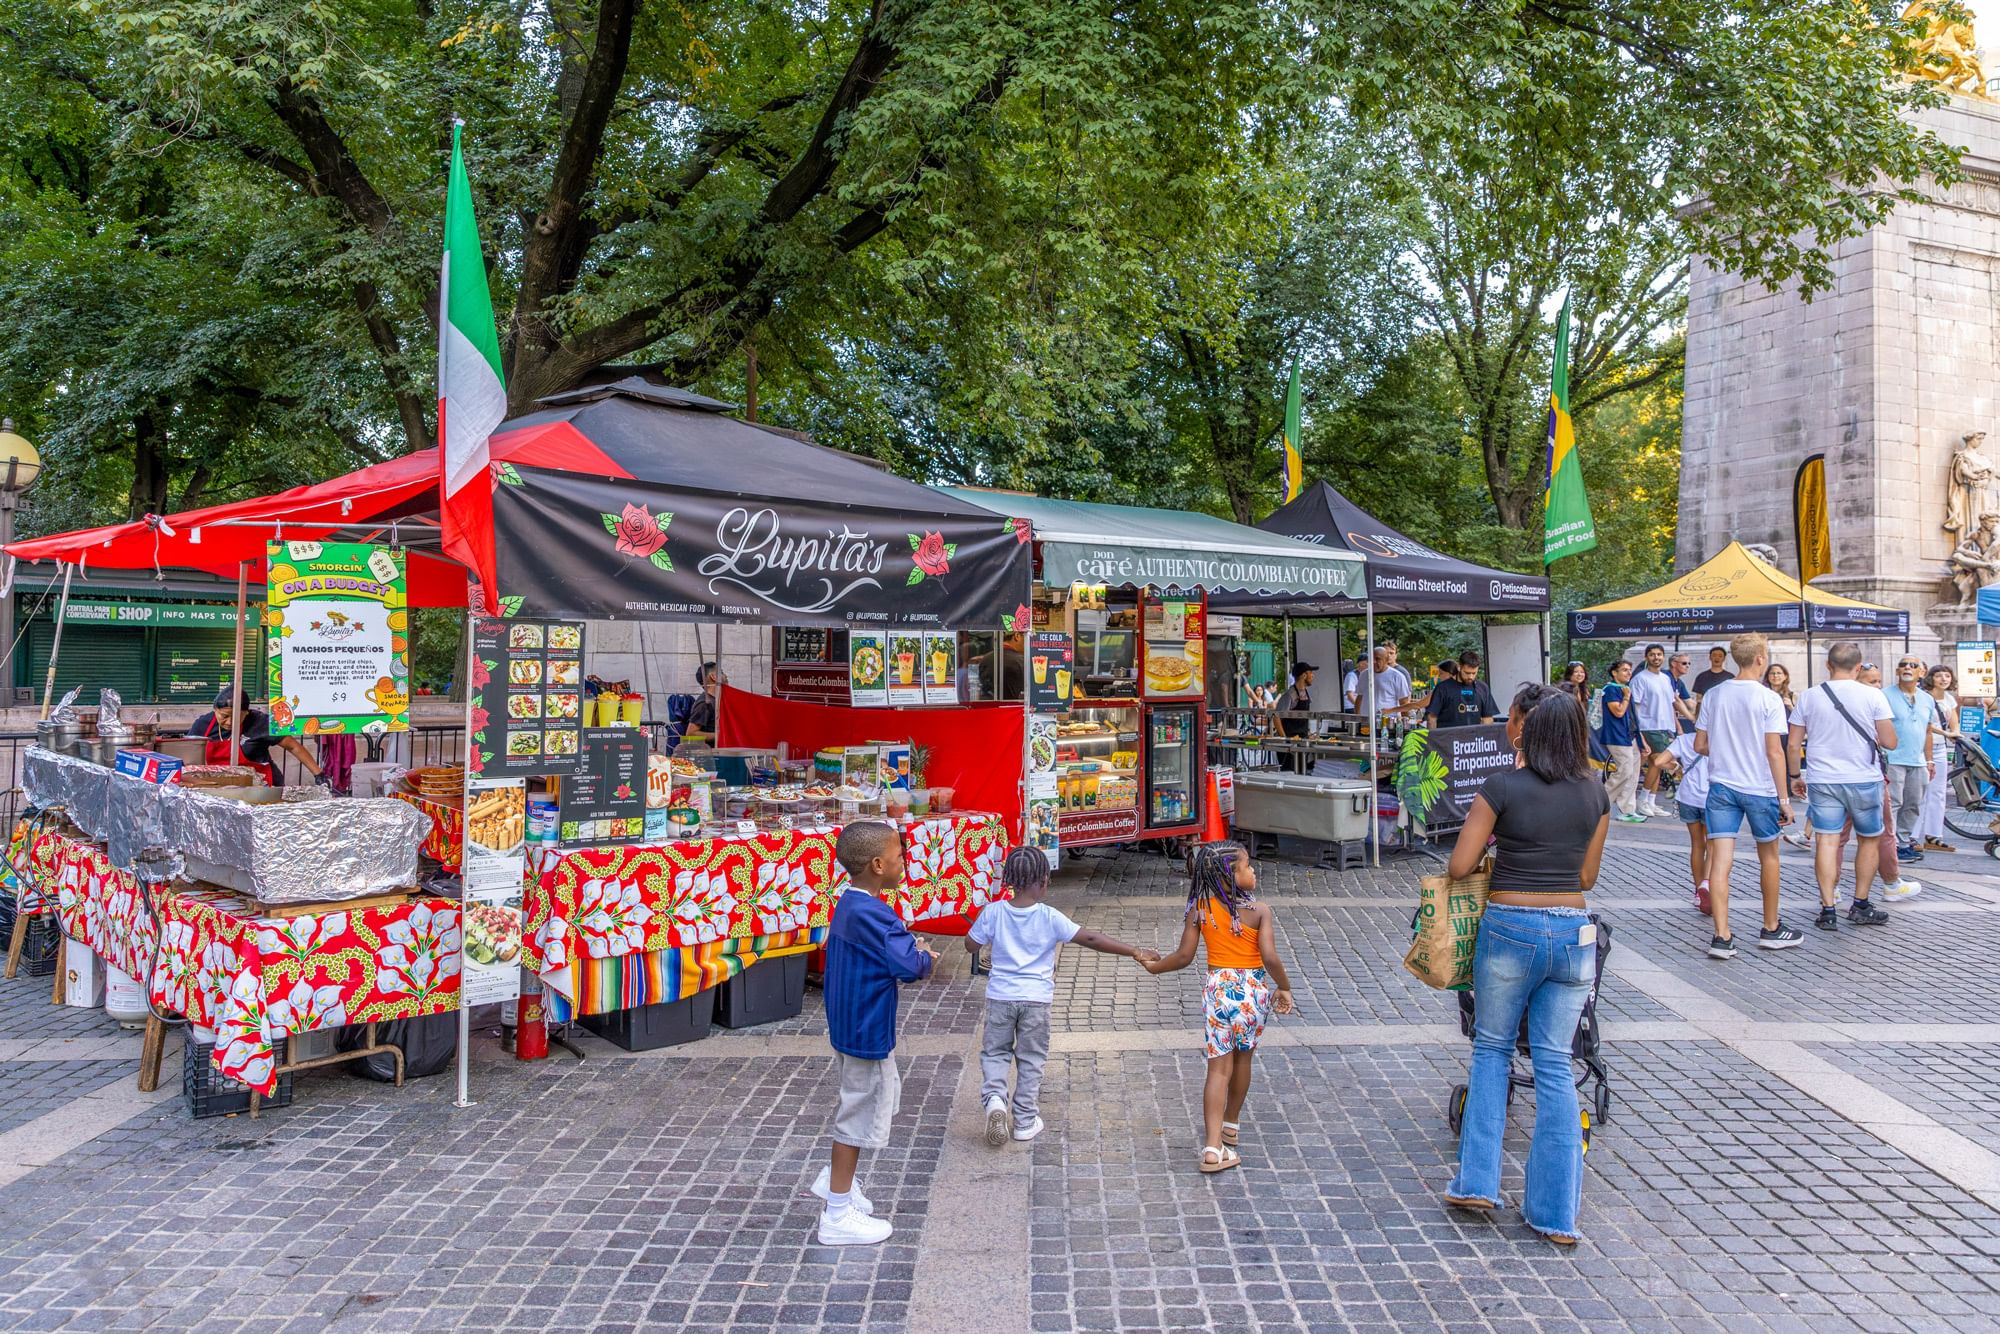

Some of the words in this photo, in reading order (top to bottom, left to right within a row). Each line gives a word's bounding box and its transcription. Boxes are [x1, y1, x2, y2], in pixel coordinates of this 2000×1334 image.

[1809, 504, 1818, 537] spoon
[1546, 520, 1585, 539] Brazilian
[1568, 529, 1594, 544] Food
[293, 544, 314, 556] $$$
[698, 507, 889, 587] Lupita's
[1810, 548, 1820, 569] bap
[309, 564, 364, 572] SMORGIN'
[1136, 560, 1218, 580] AUTHENTIC
[1220, 562, 1299, 584] COLOMBIAN
[1302, 568, 1348, 586] COFFEE
[284, 580, 306, 594] ON
[310, 580, 322, 590] A
[324, 578, 390, 596] BUDGET
[1376, 575, 1416, 592] Brazilian
[1418, 580, 1446, 592] Street
[1446, 581, 1468, 594] Food
[1502, 583, 1546, 596] PetiscoBrazuca
[66, 611, 110, 620] CONSERVANCY
[118, 606, 152, 620] SHOP
[625, 602, 659, 612] AUTHENTIC
[660, 603, 687, 612] MEXICAN
[688, 604, 706, 614] FOOD
[722, 606, 752, 615] BROOKLYN,
[754, 608, 761, 616] NY
[856, 612, 888, 620] @LUPITASNYC
[1646, 609, 1680, 620] spoon
[1682, 609, 1690, 618] &
[1692, 608, 1714, 618] bap
[1848, 609, 1862, 618] spoon
[788, 674, 817, 686] Authentic
[1453, 737, 1497, 755] Brazilian
[1454, 752, 1514, 774] Empanadas
[1454, 779, 1469, 788] Pastel
[1077, 820, 1114, 832] Colombian
[1114, 818, 1135, 827] Coffee
[1449, 894, 1478, 914] IT'S
